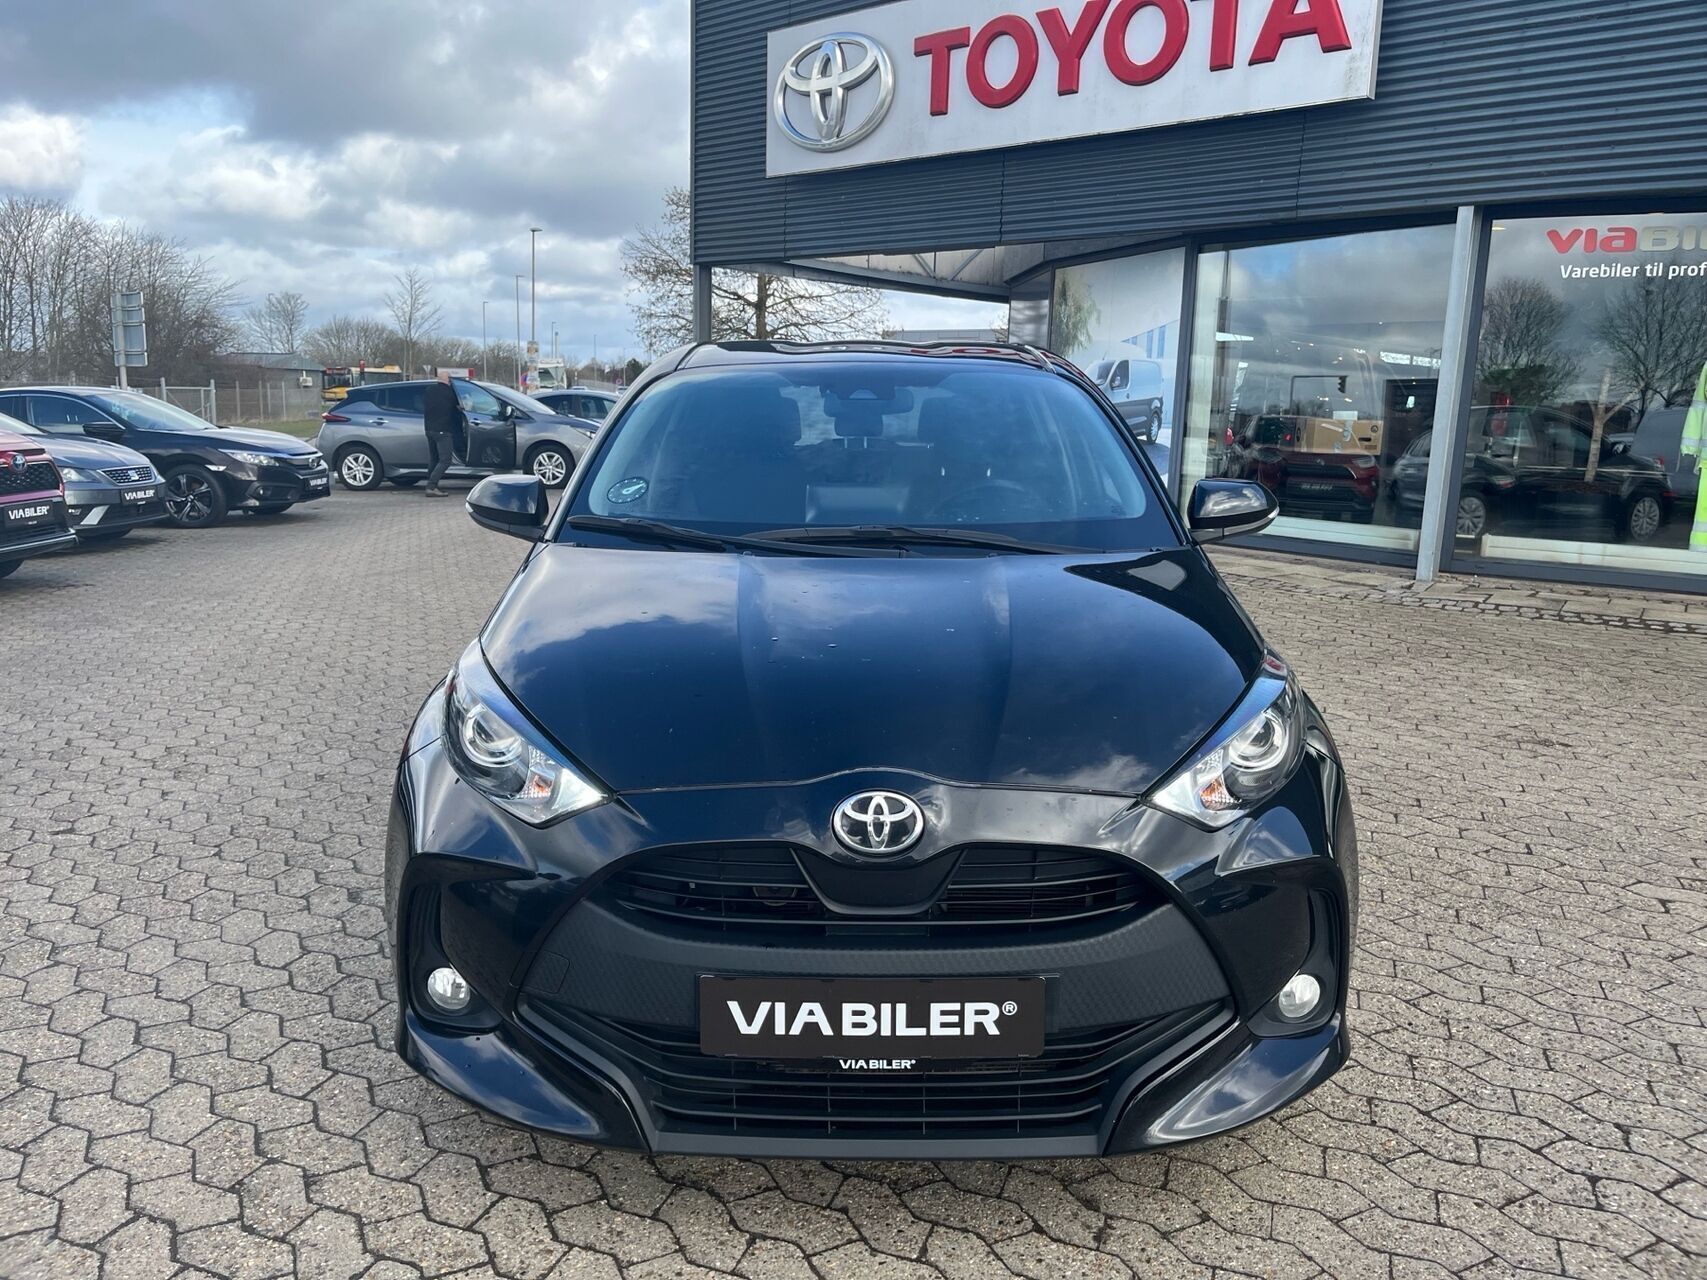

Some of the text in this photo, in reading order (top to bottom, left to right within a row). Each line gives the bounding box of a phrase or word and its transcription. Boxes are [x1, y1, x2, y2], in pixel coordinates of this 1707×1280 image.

[914, 0, 1352, 117] TOYOTA
[1560, 263, 1640, 279] Varebiler
[1645, 262, 1664, 277] til
